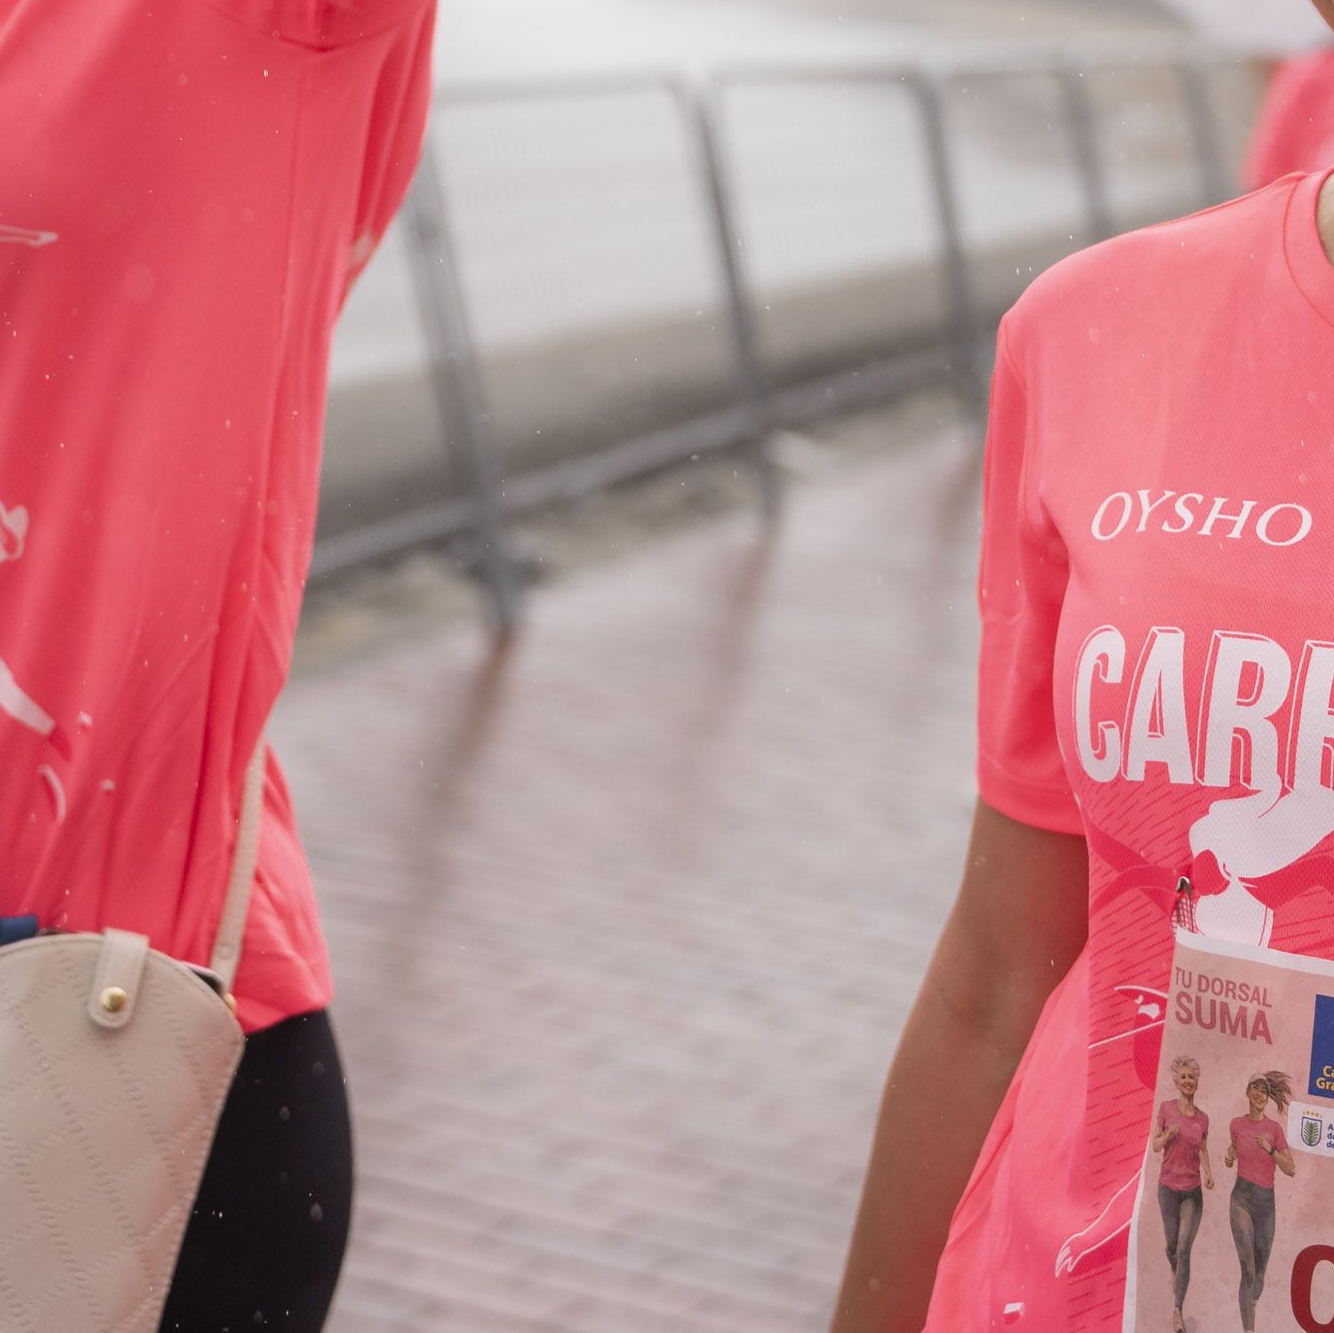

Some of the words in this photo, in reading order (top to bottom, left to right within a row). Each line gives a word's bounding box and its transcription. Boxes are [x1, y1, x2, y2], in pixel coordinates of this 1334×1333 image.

[1091, 489, 1313, 546] OYSHO
[1174, 967, 1193, 989] TU
[1197, 974, 1272, 1008] DORSAL
[1175, 991, 1273, 1045] SUMA
